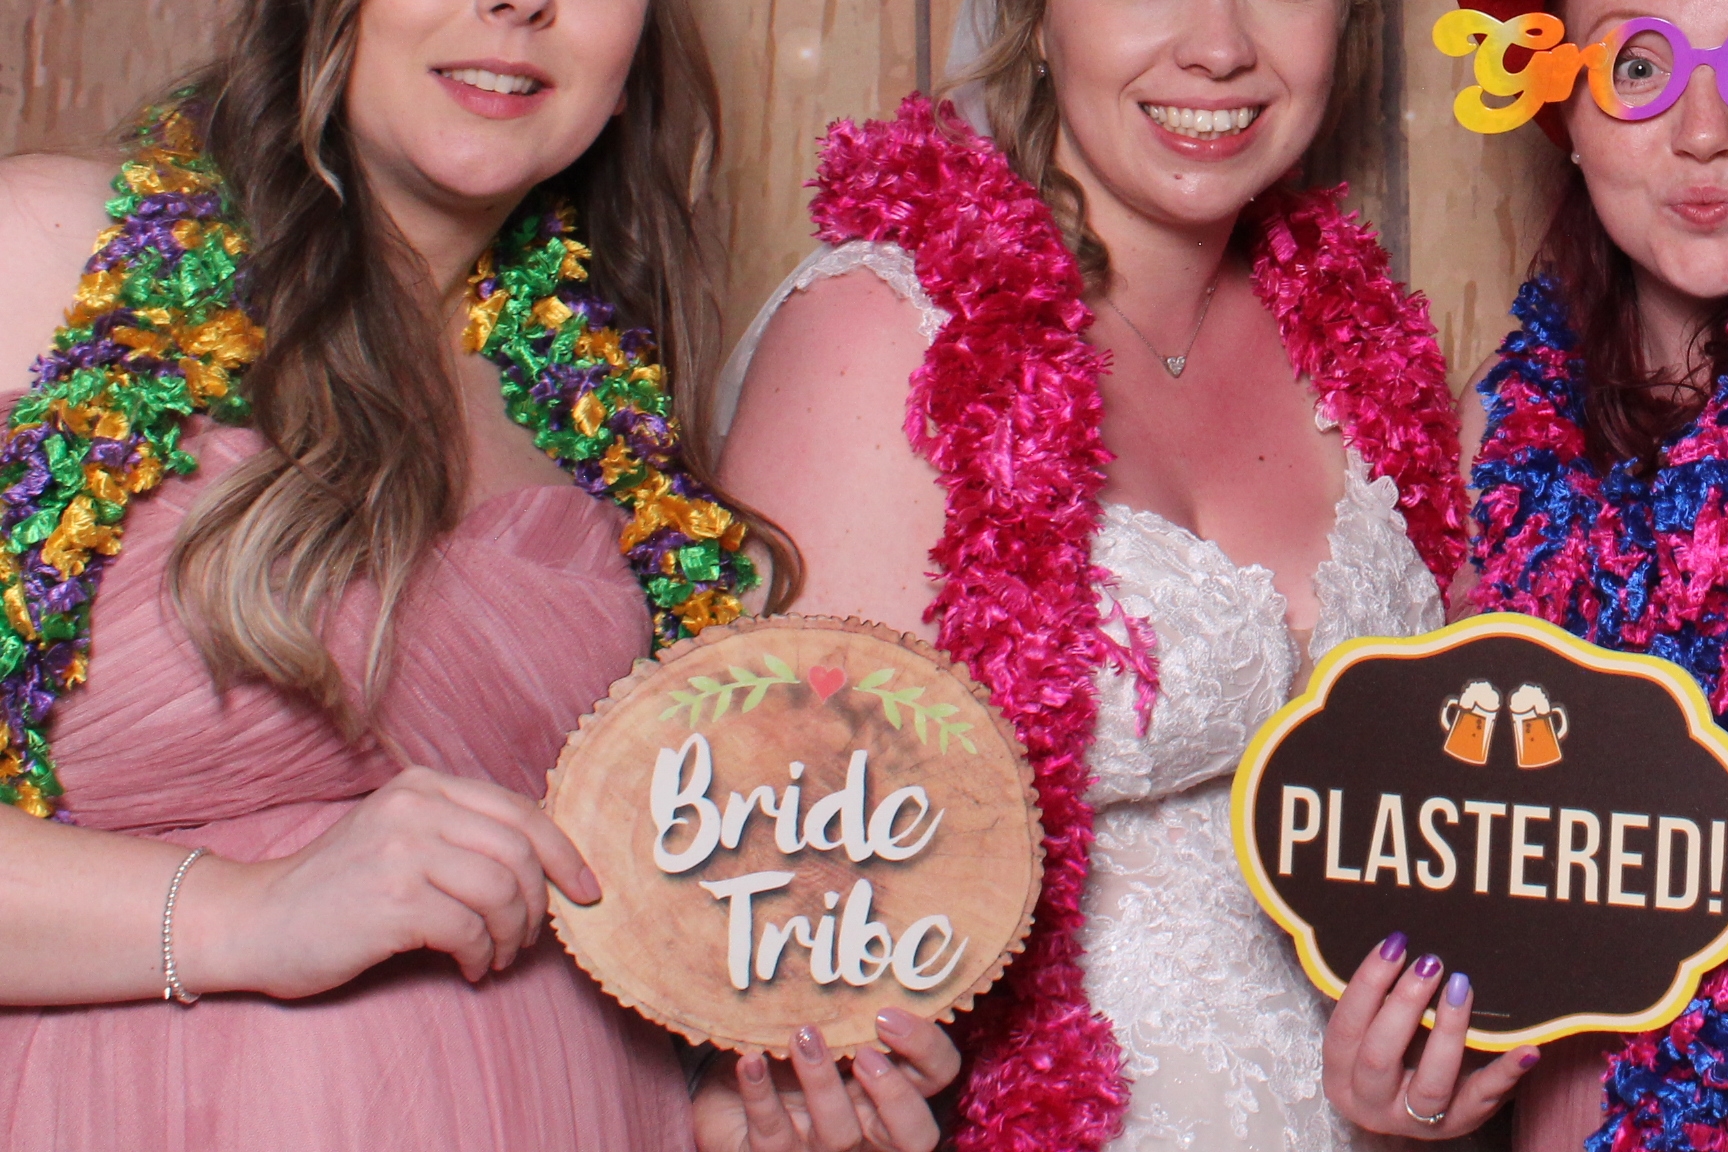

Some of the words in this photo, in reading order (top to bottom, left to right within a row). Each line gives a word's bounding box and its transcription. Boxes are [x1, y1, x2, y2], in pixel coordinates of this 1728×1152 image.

[649, 732, 946, 874] Bride
[1278, 784, 1727, 915] PLASTERED!
[699, 871, 969, 991] Tribe
